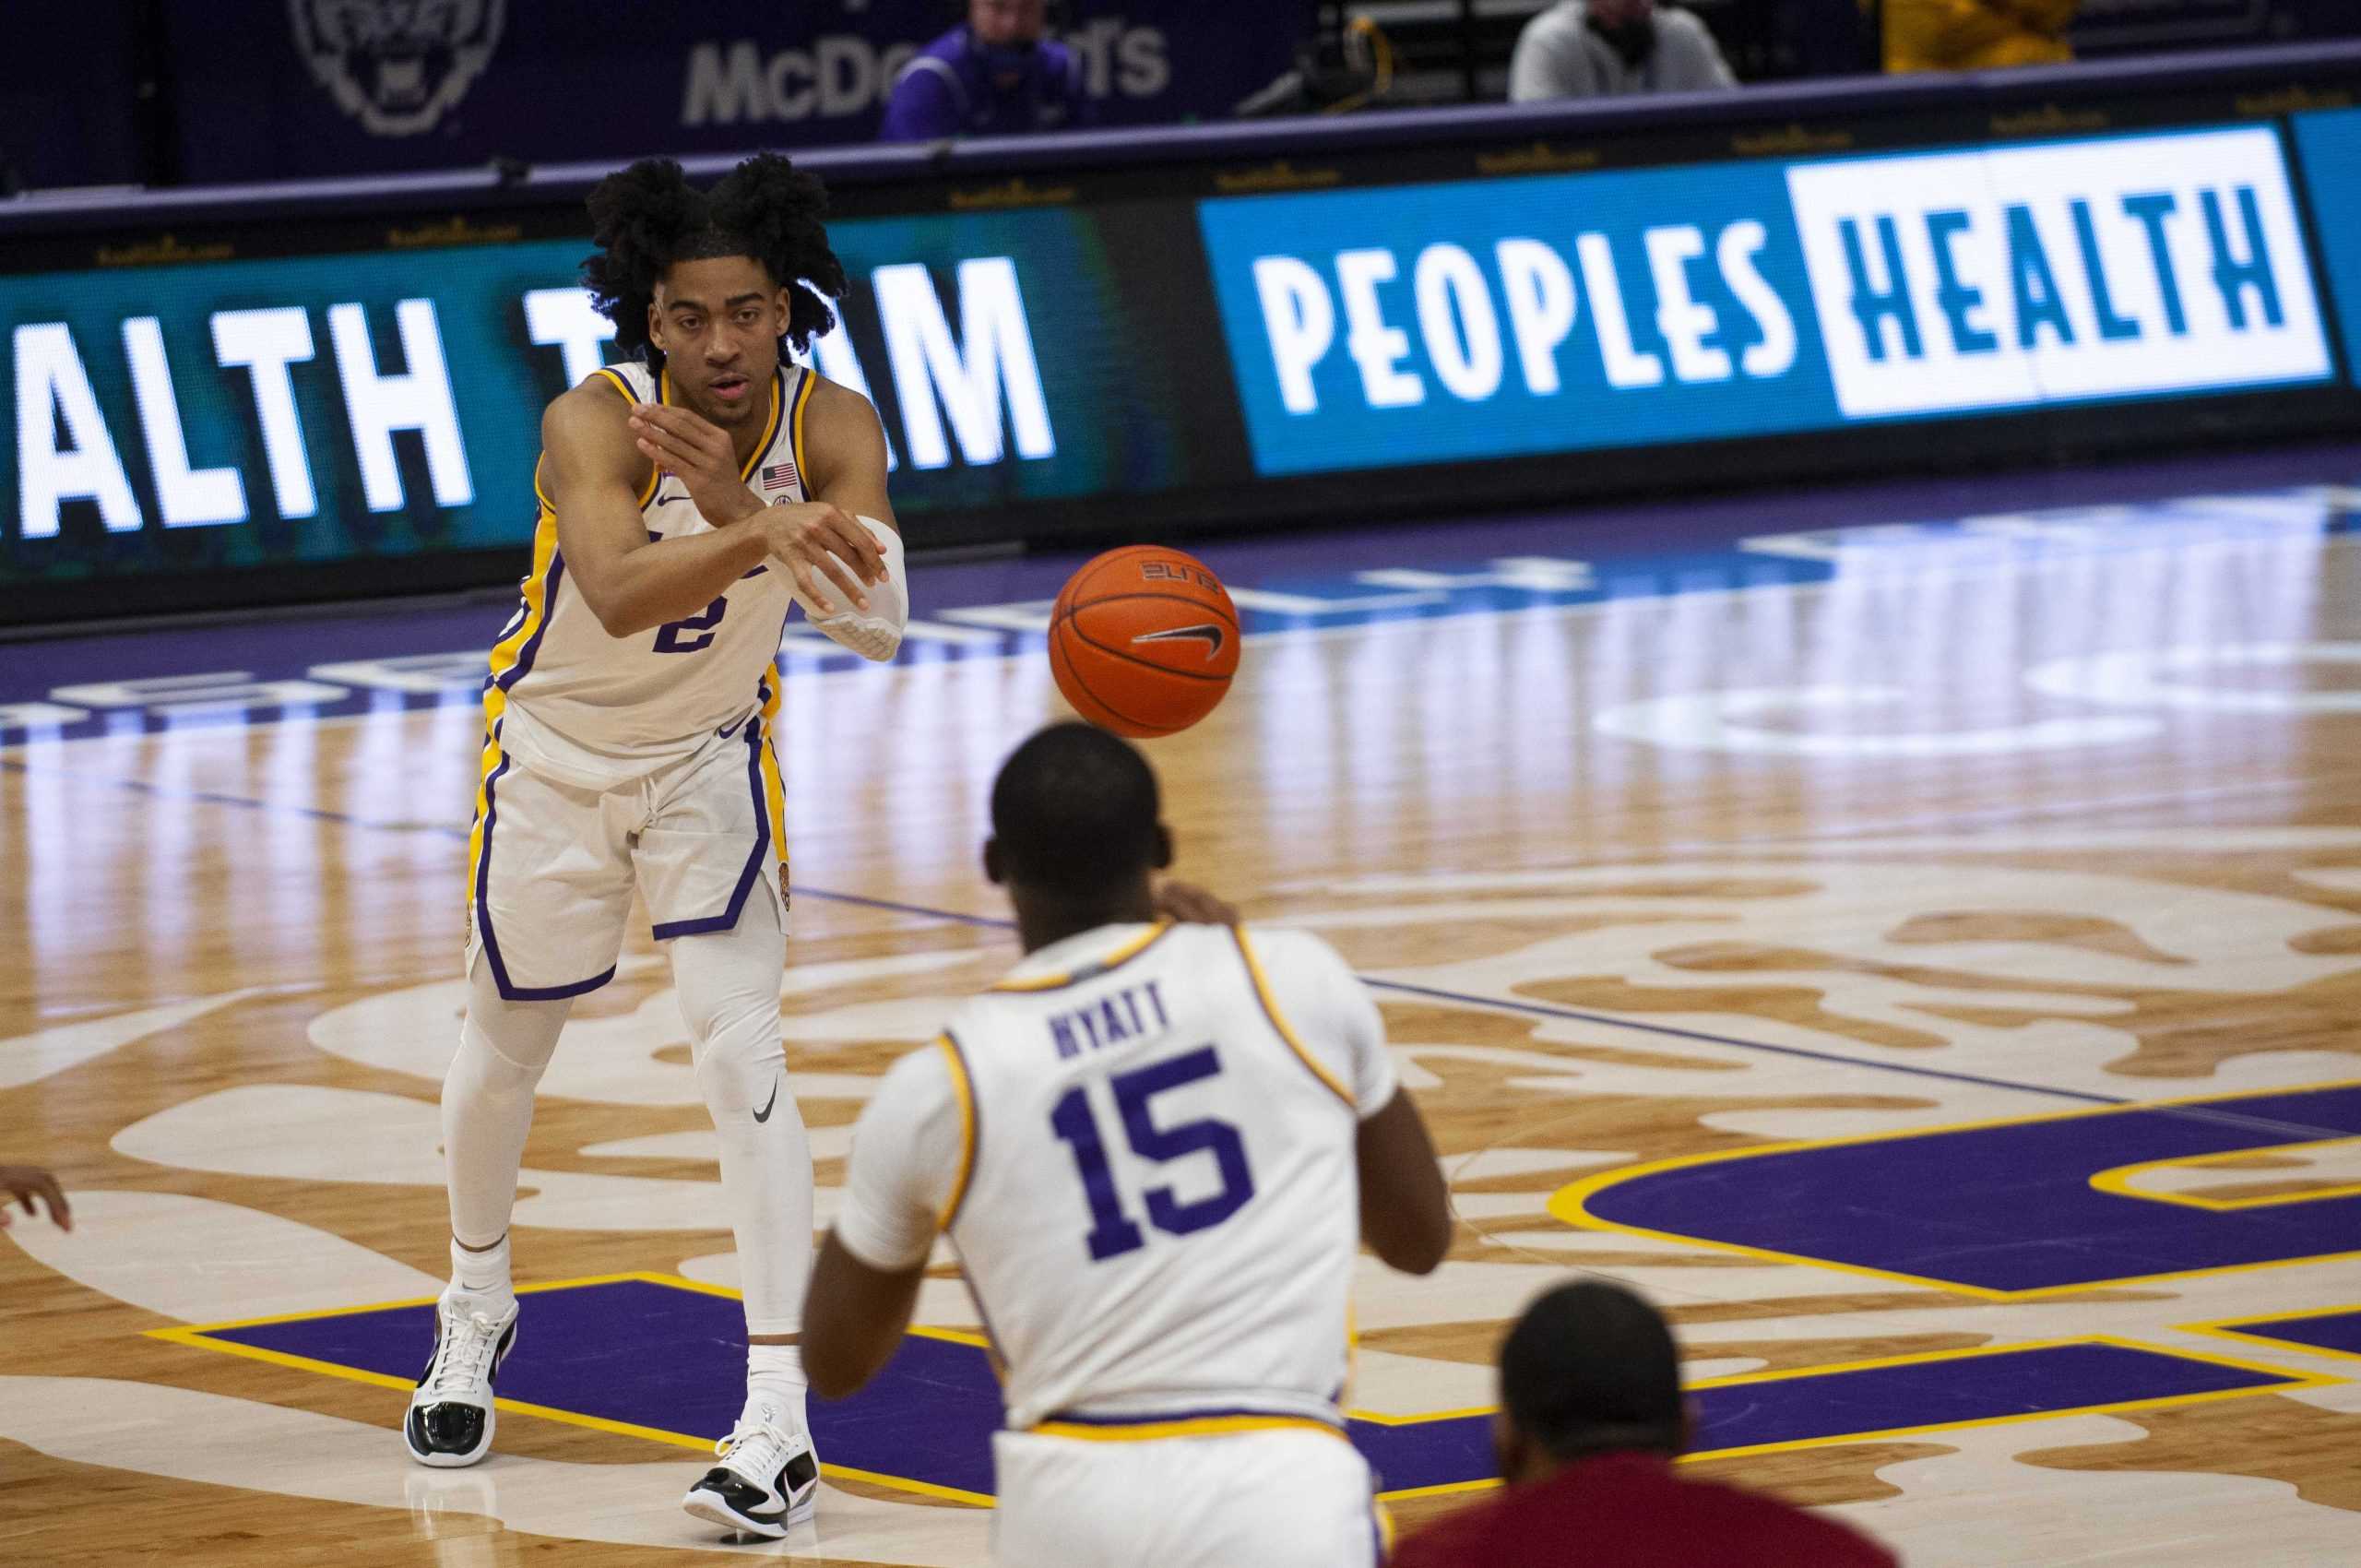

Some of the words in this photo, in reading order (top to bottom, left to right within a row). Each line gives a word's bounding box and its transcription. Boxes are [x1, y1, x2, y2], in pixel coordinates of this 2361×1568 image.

[0, 297, 476, 540] ALTH
[522, 255, 1056, 473] TAM
[1252, 218, 1798, 415] PEOPLES
[1836, 184, 2284, 363] HEALTH
[1140, 561, 1221, 597] ELITE
[1048, 980, 1168, 1061] HYATT
[1050, 1042, 1255, 1263] 15
